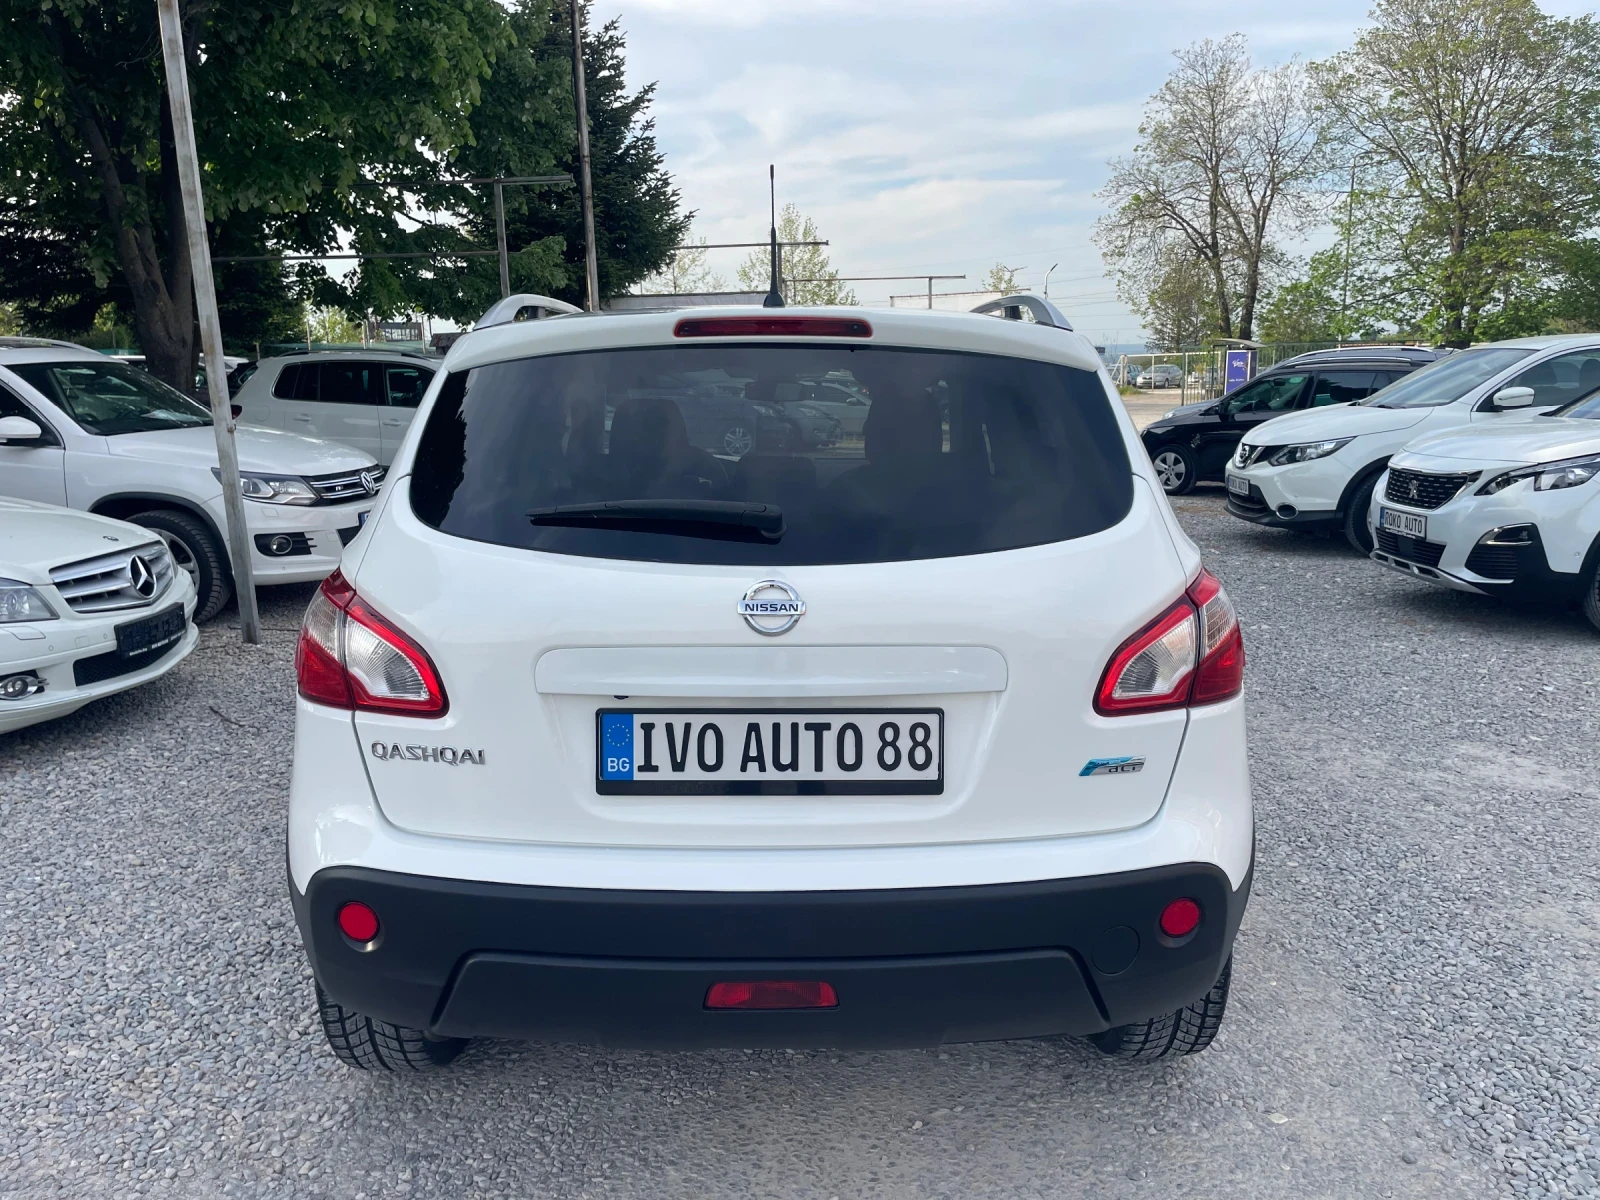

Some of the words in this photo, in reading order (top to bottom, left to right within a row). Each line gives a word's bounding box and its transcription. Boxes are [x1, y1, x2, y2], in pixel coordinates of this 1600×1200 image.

[1384, 511, 1401, 528] ROKO
[1404, 516, 1423, 534] AUTO
[744, 603, 799, 612] NISSAN
[371, 740, 486, 766] QASHQAI
[637, 722, 724, 772] IVO
[740, 722, 863, 772] AUTO
[877, 721, 933, 771] 88
[607, 757, 630, 772] BG
